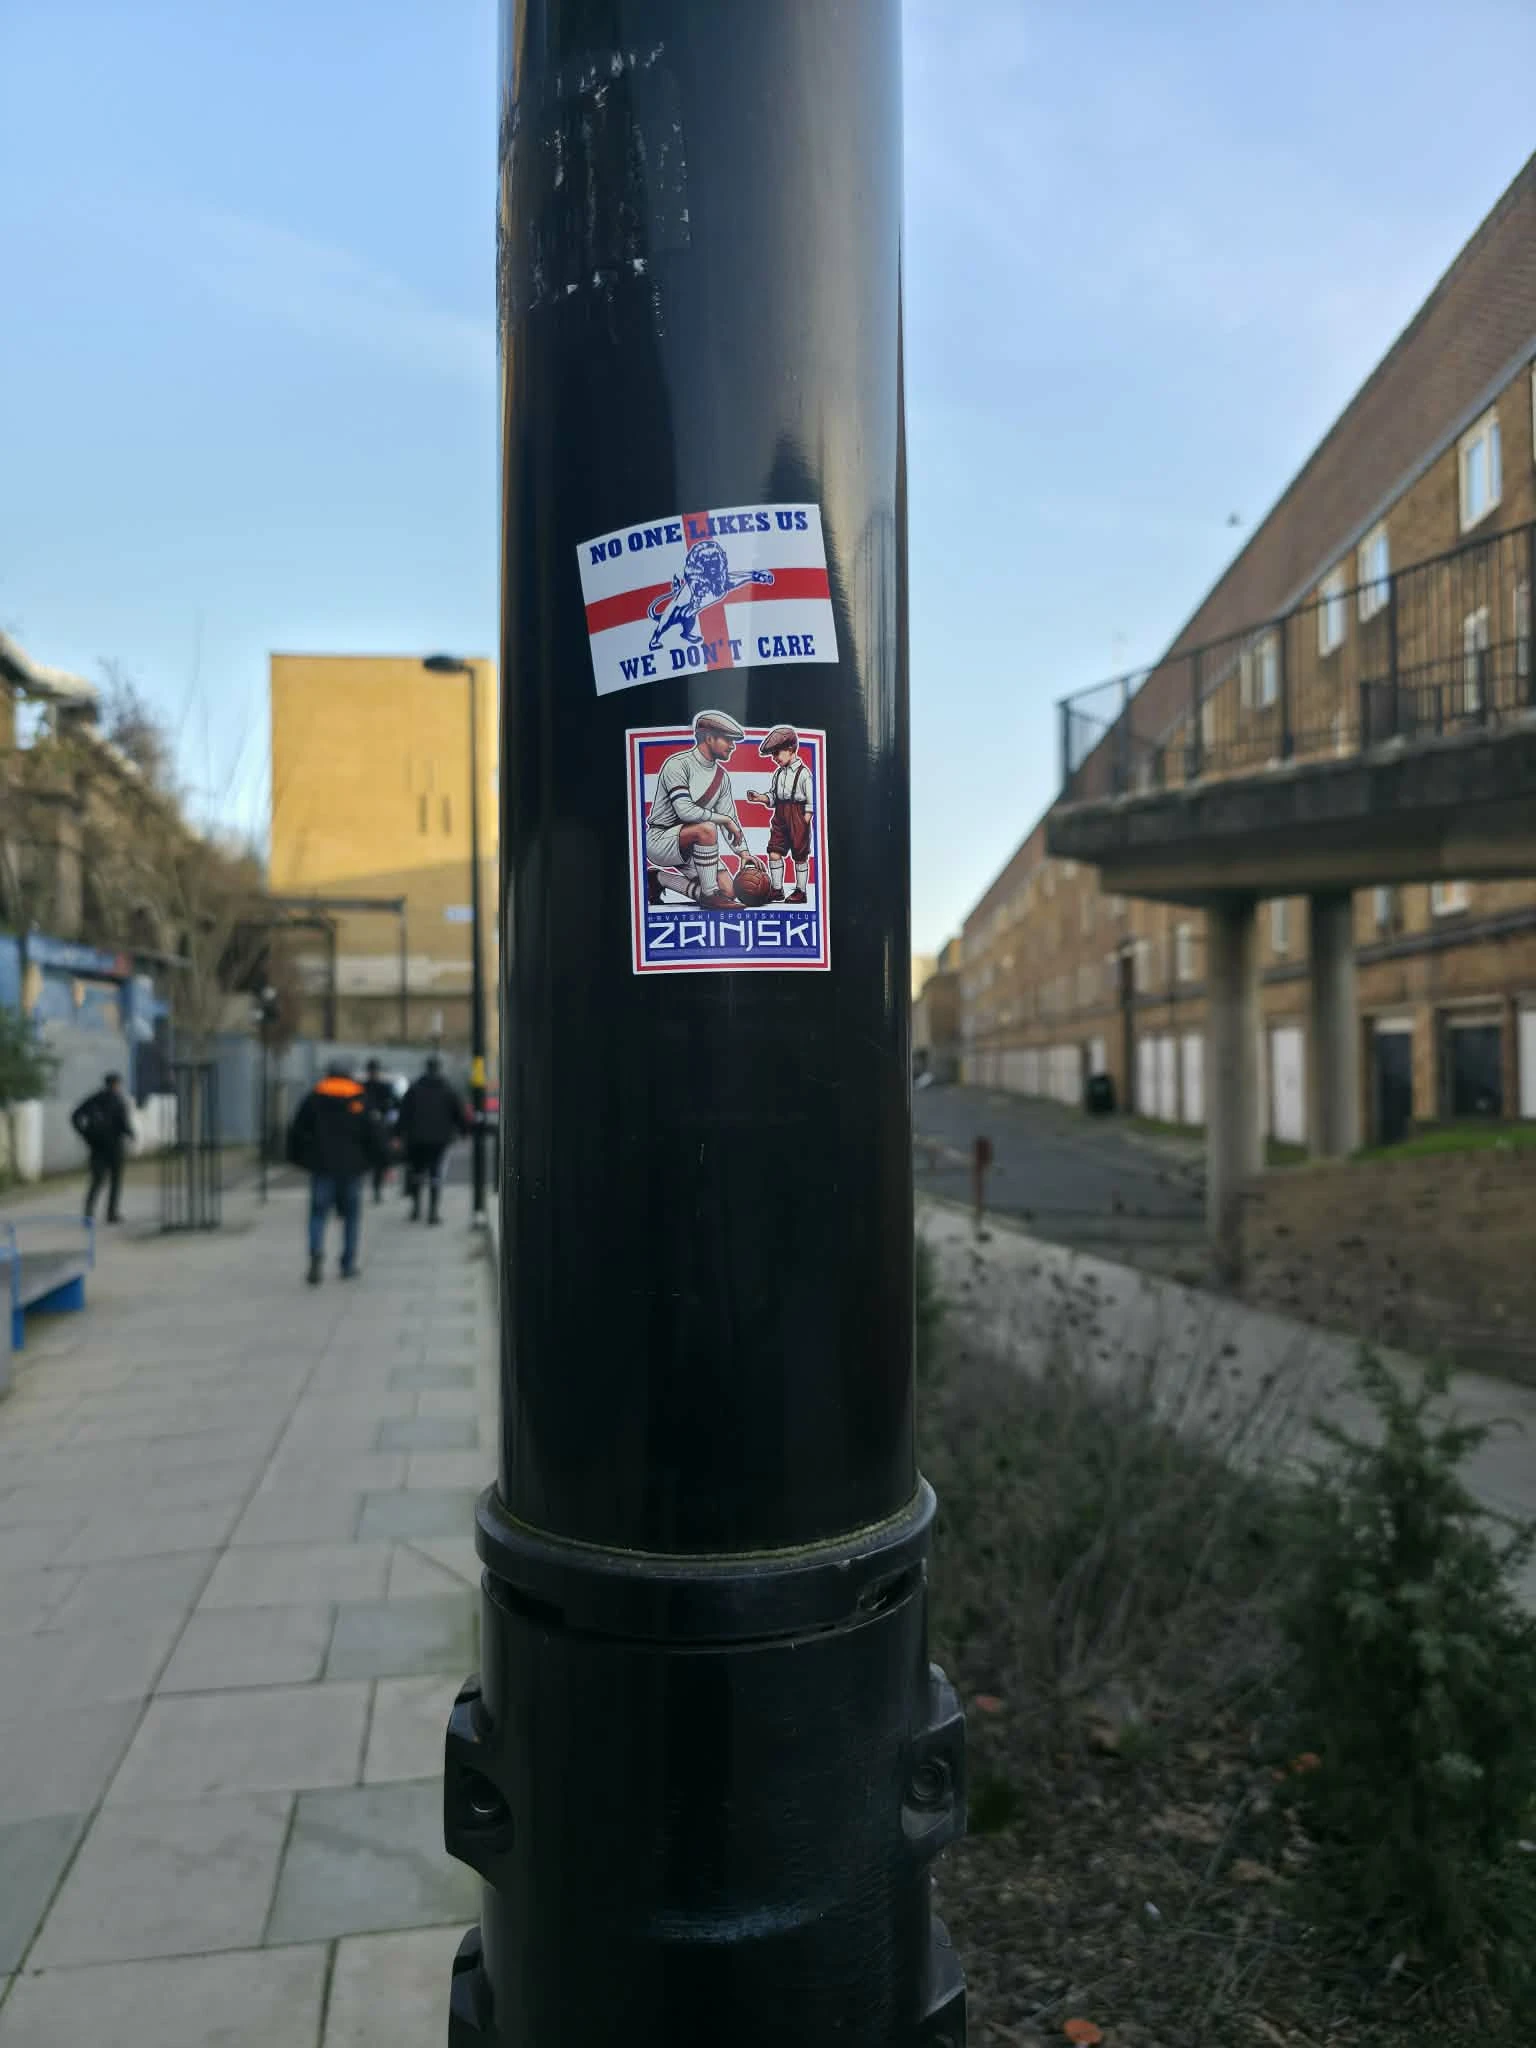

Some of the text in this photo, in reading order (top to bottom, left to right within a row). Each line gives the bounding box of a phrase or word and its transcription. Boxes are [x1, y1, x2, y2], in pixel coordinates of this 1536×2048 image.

[590, 511, 808, 565] NO ONE LIKES US
[620, 634, 816, 681] WE DON'T CARE
[648, 920, 816, 952] ZRINJSKI
